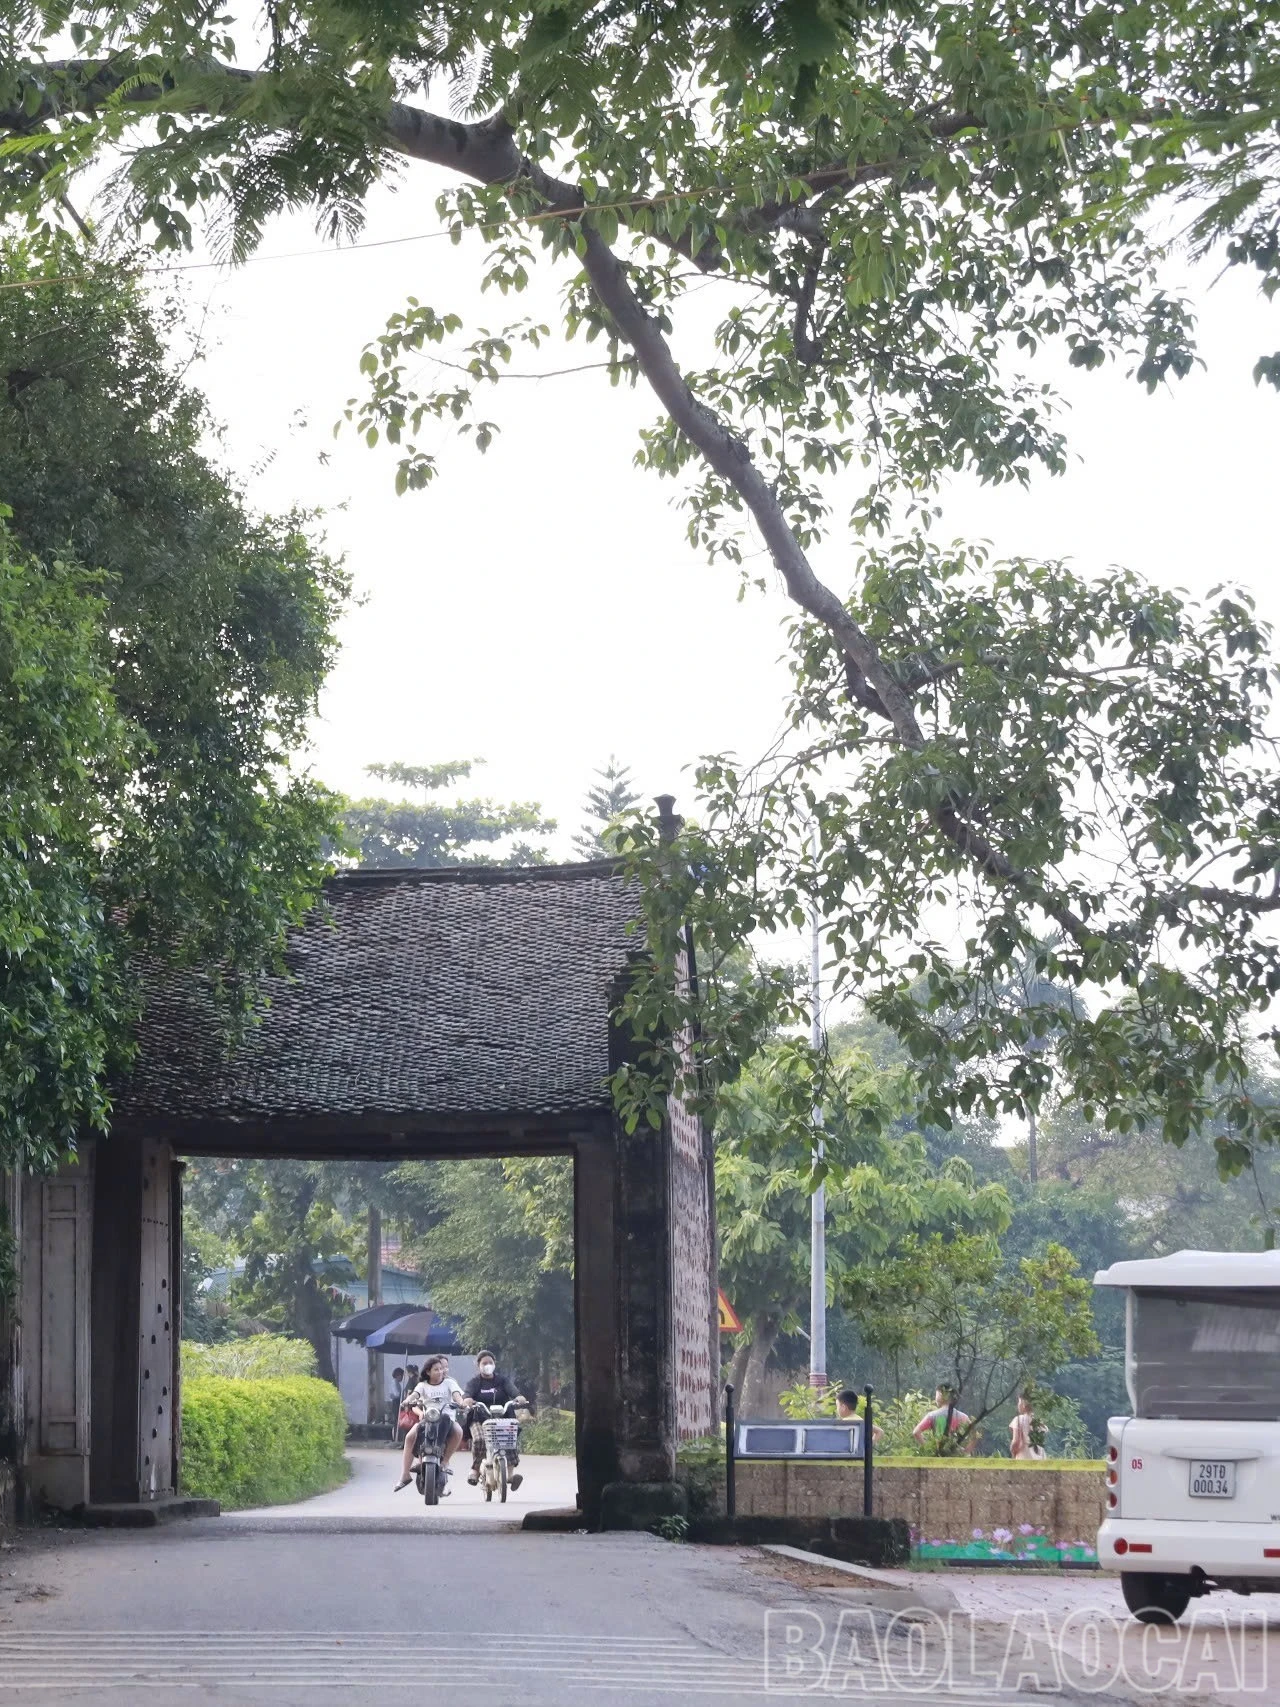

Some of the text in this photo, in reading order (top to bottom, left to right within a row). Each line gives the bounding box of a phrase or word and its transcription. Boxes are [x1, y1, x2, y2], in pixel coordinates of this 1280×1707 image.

[1131, 1459, 1143, 1470] 05
[1199, 1464, 1226, 1479] 29TĐ
[1193, 1480, 1228, 1494] 000.34
